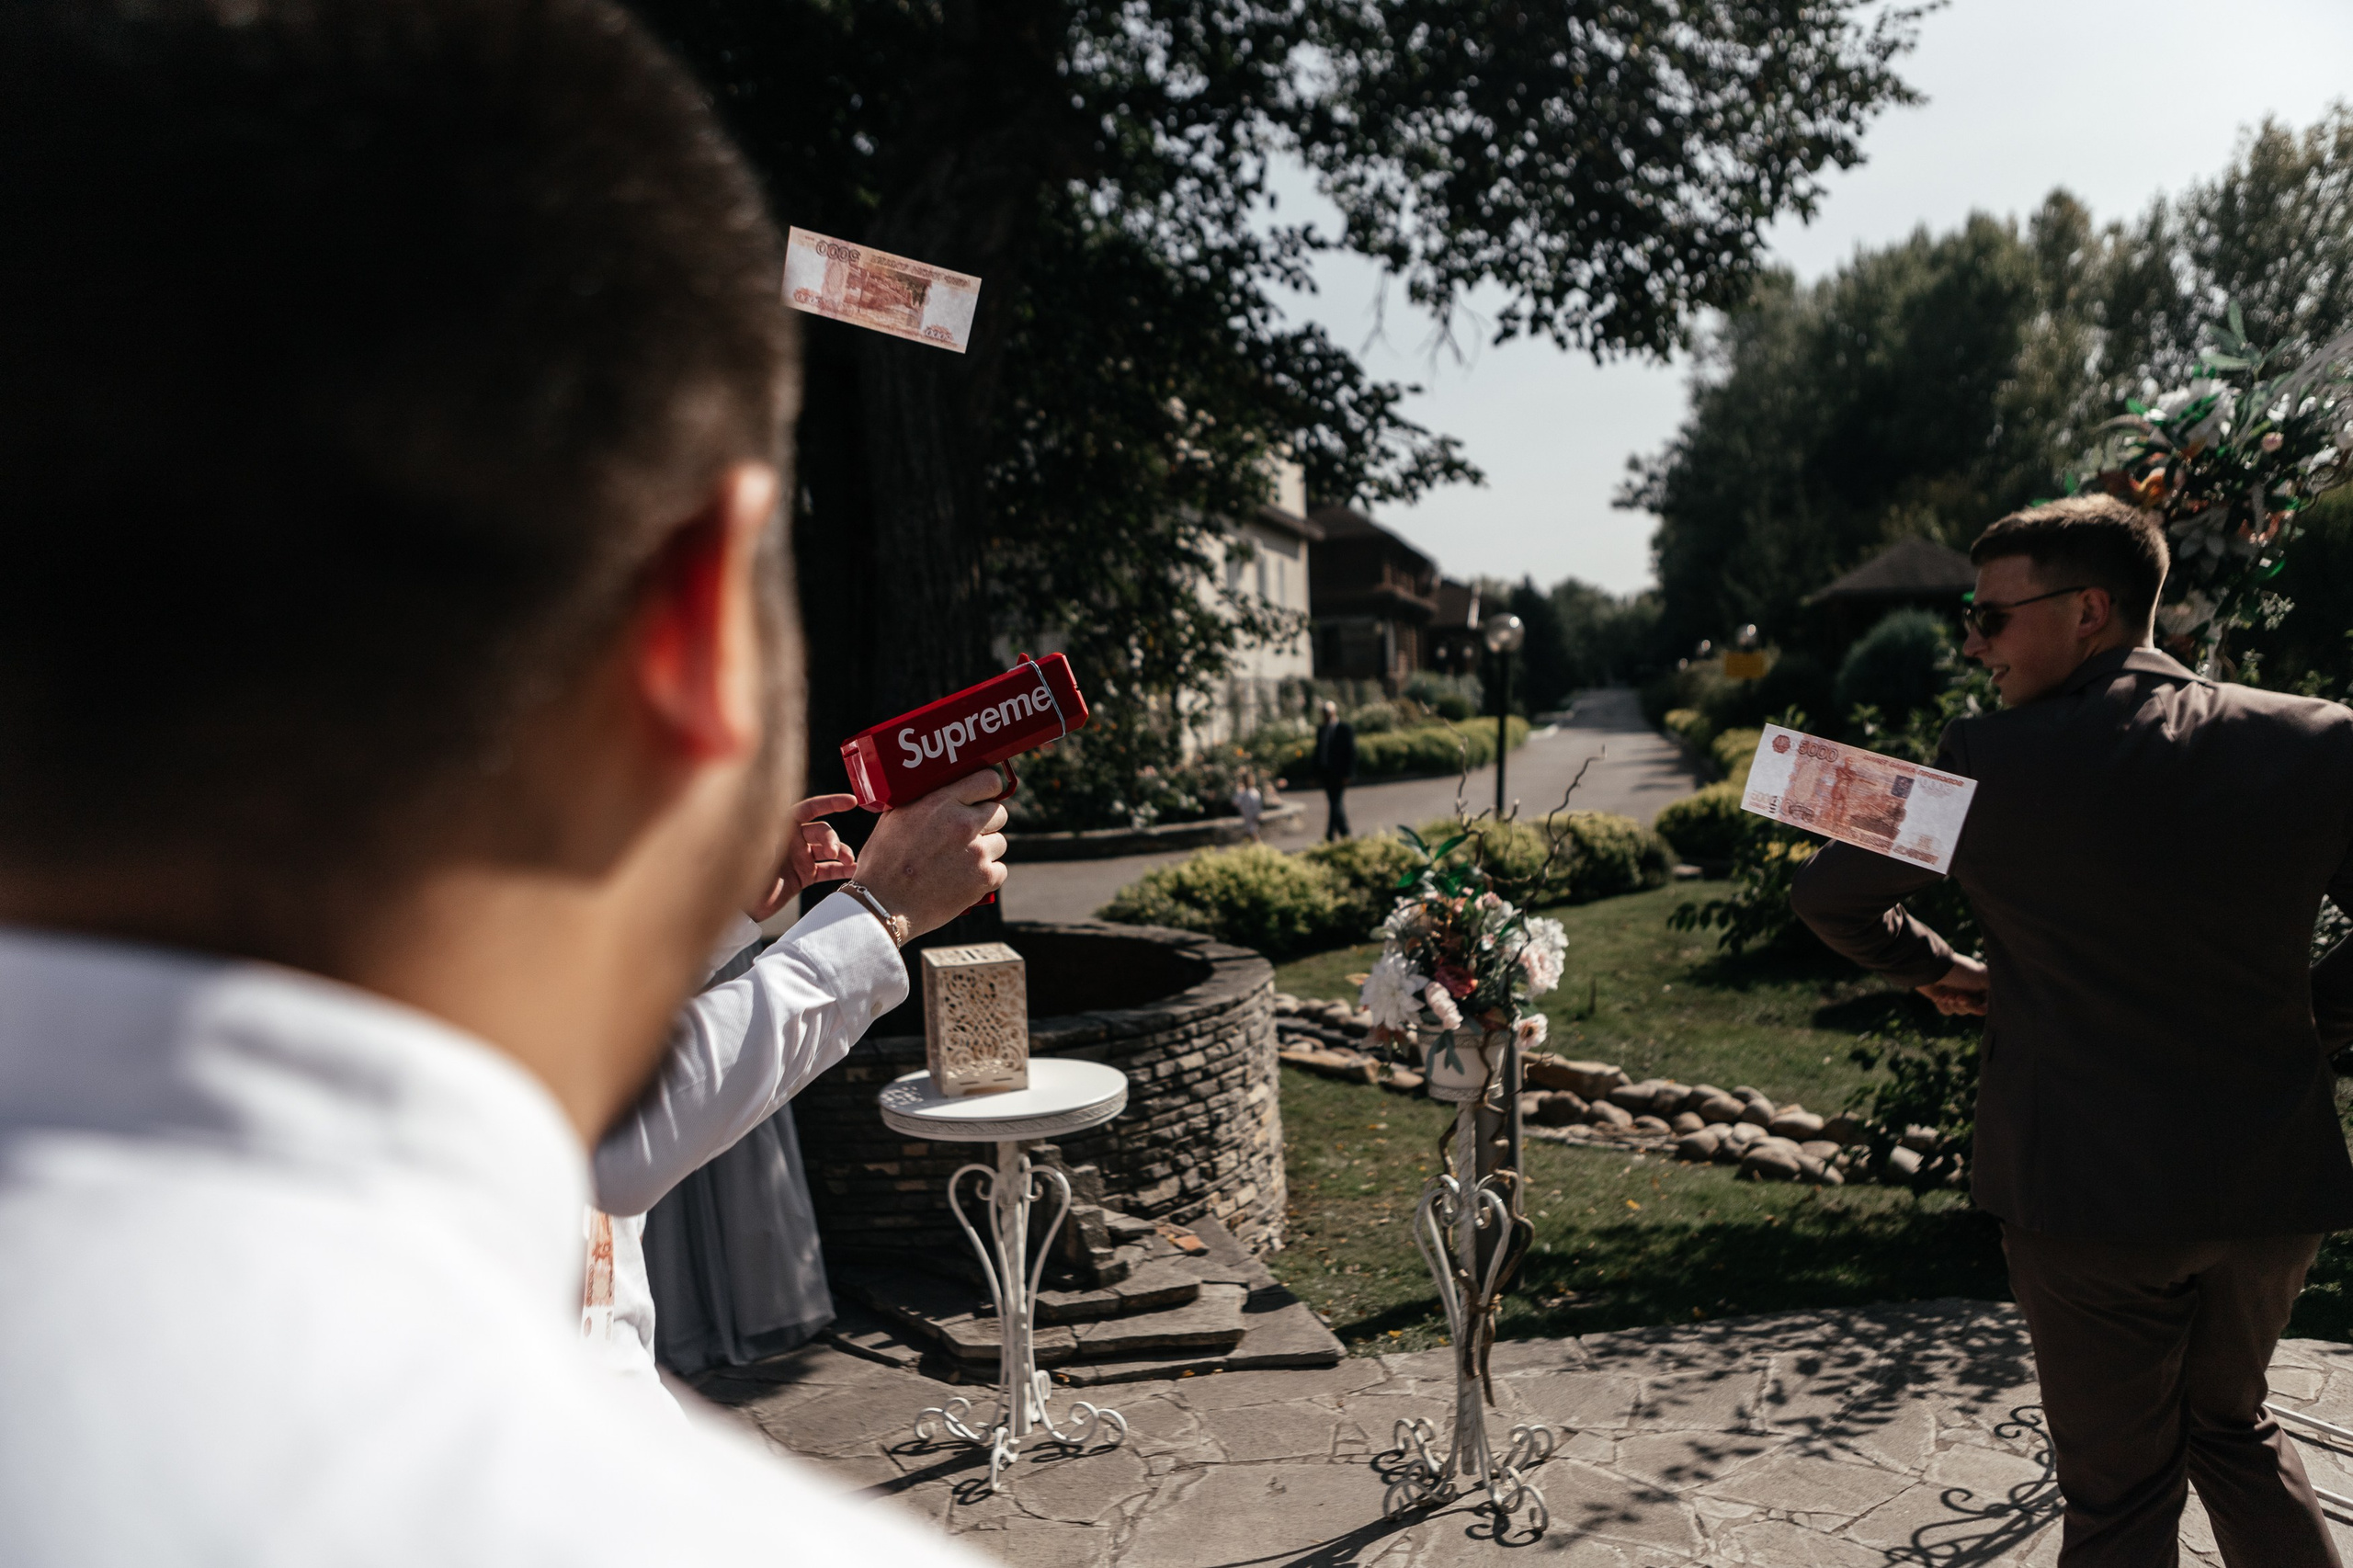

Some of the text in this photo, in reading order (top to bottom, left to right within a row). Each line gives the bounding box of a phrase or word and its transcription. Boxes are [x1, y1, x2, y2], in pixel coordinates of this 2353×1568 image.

[815, 240, 861, 263] 5000
[898, 686, 1053, 769] Supreme
[1798, 740, 1839, 763] 5000
